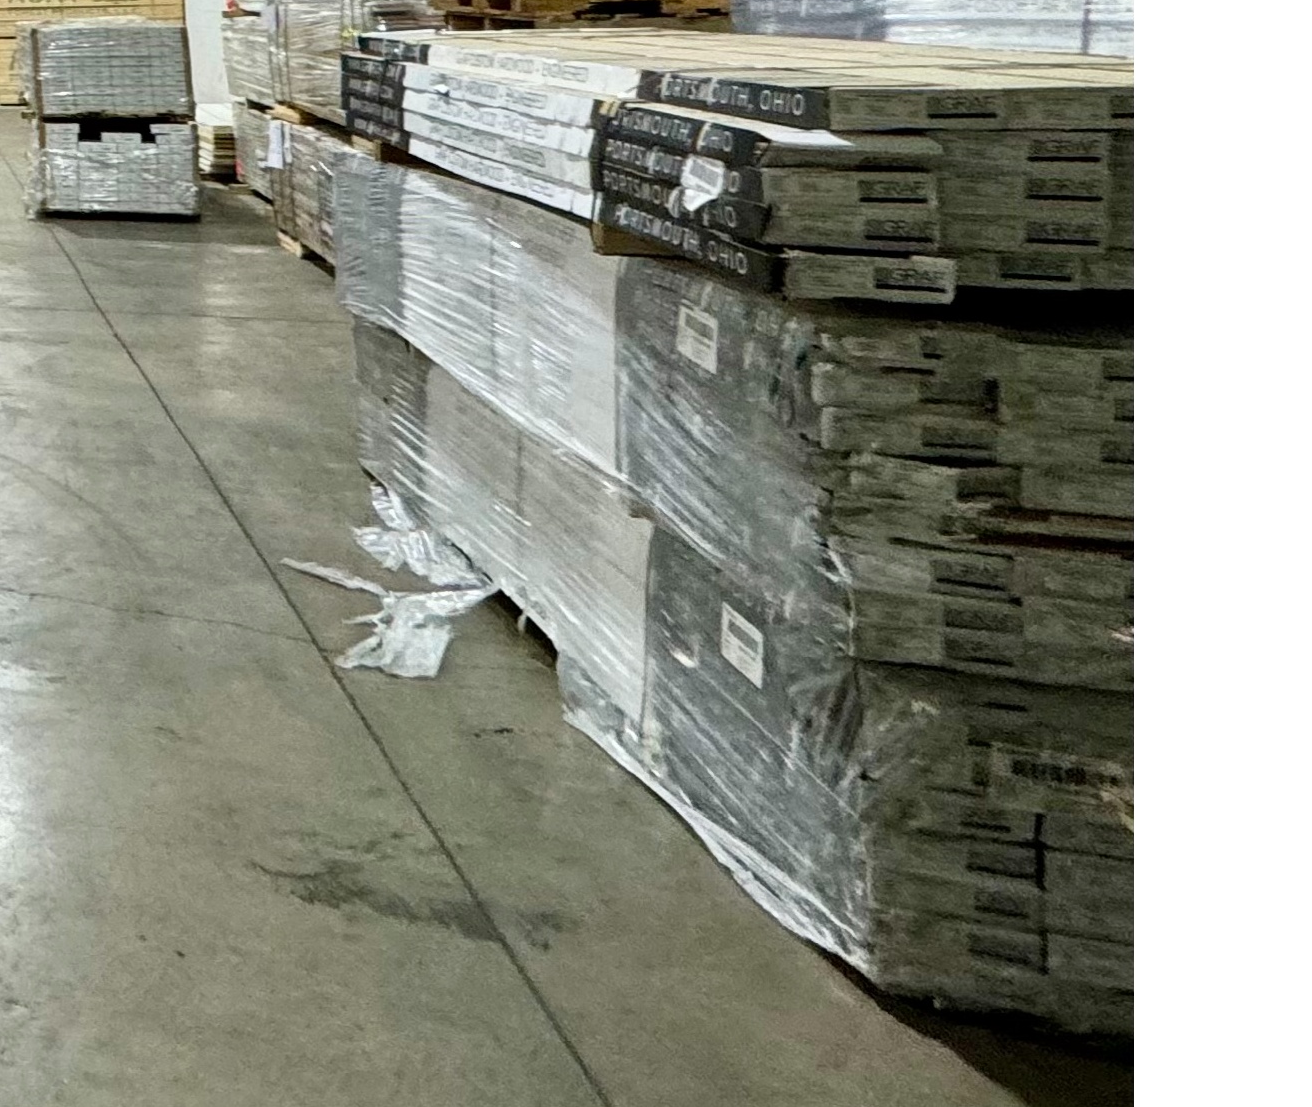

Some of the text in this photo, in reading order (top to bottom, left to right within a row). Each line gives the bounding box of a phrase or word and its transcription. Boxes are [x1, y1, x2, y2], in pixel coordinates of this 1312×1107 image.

[658, 73, 806, 117] ORTSMOUTH, OHIO
[709, 239, 748, 275] OHIO
